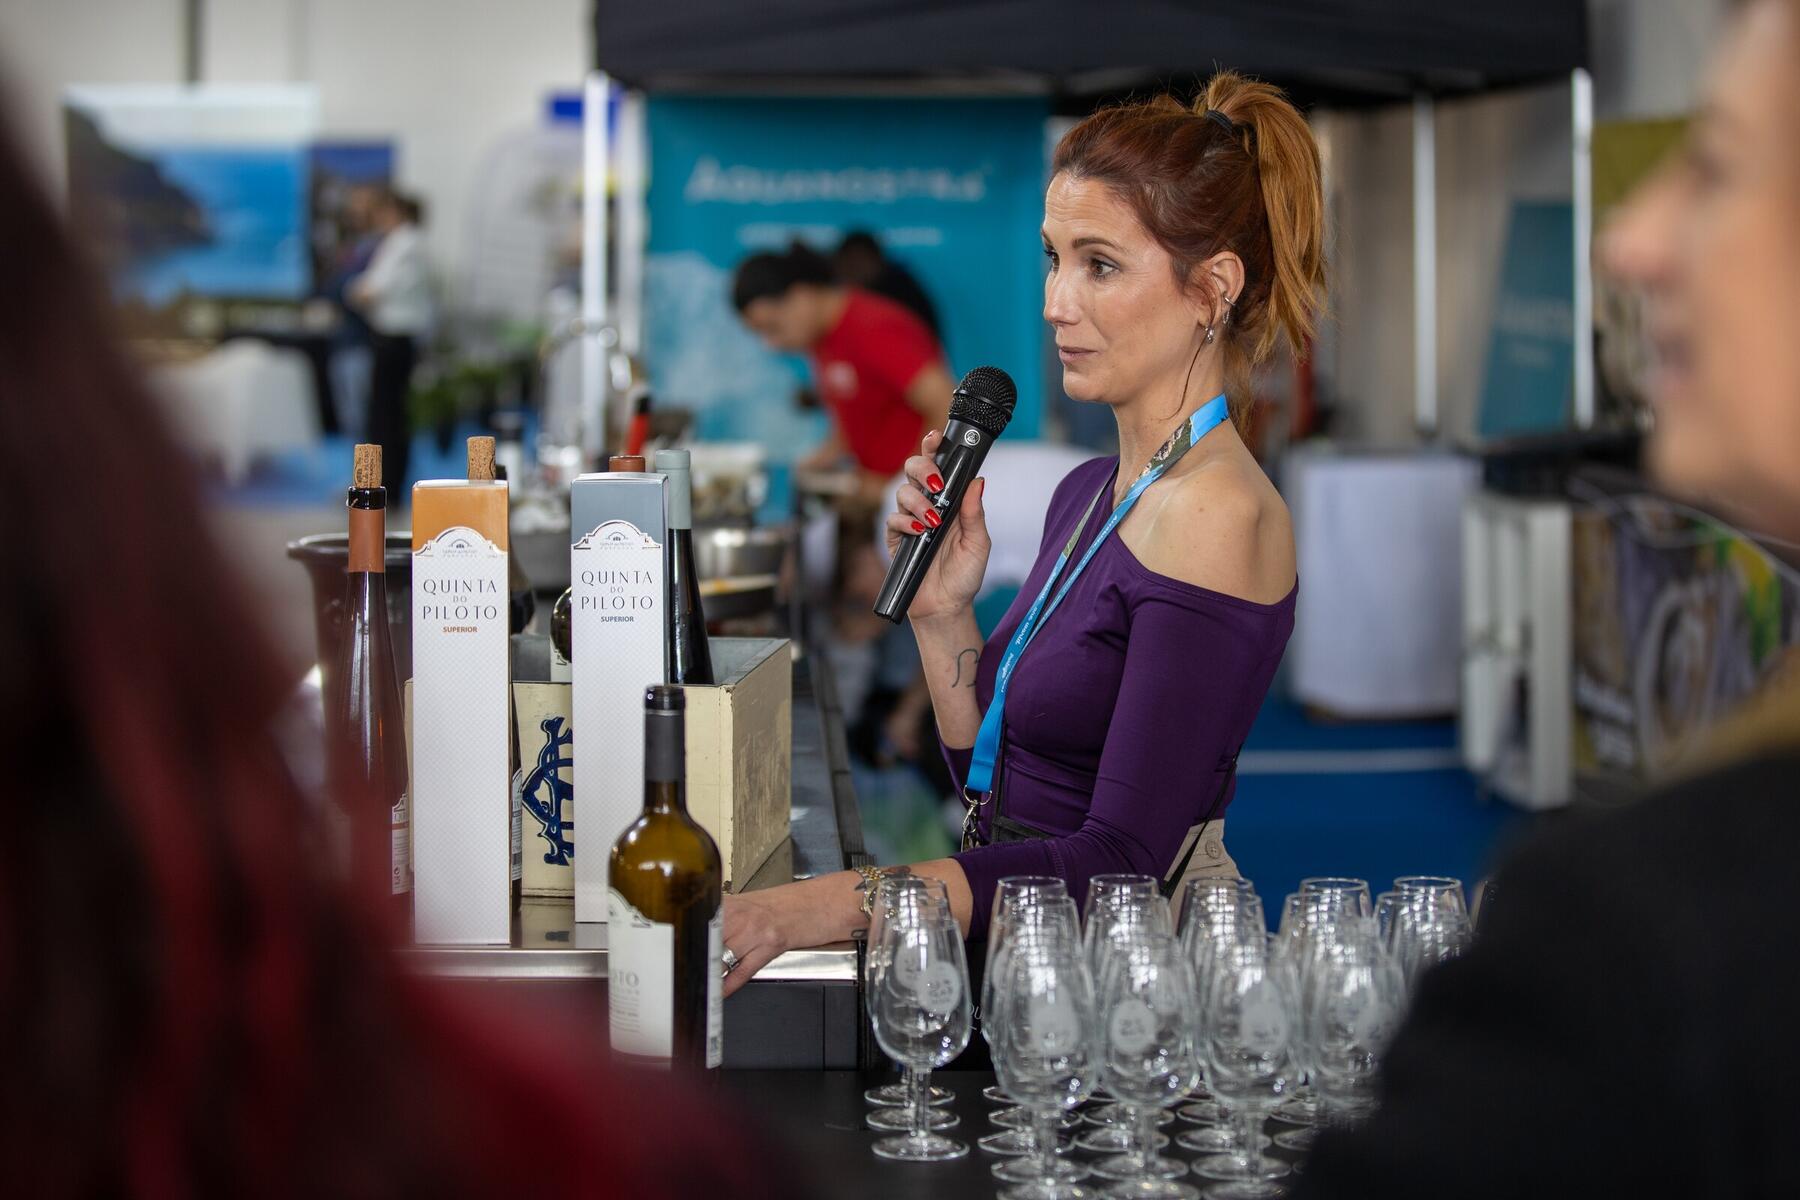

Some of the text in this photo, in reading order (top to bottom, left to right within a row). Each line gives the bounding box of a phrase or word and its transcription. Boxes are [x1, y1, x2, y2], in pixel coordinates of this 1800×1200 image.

[581, 570, 653, 586] QUINTA
[423, 578, 497, 595] QUINTA
[581, 595, 653, 610] PILOTO
[423, 605, 497, 620] PILOTO
[600, 615, 635, 623] SUPERIOR
[442, 625, 478, 633] SUPERIOR
